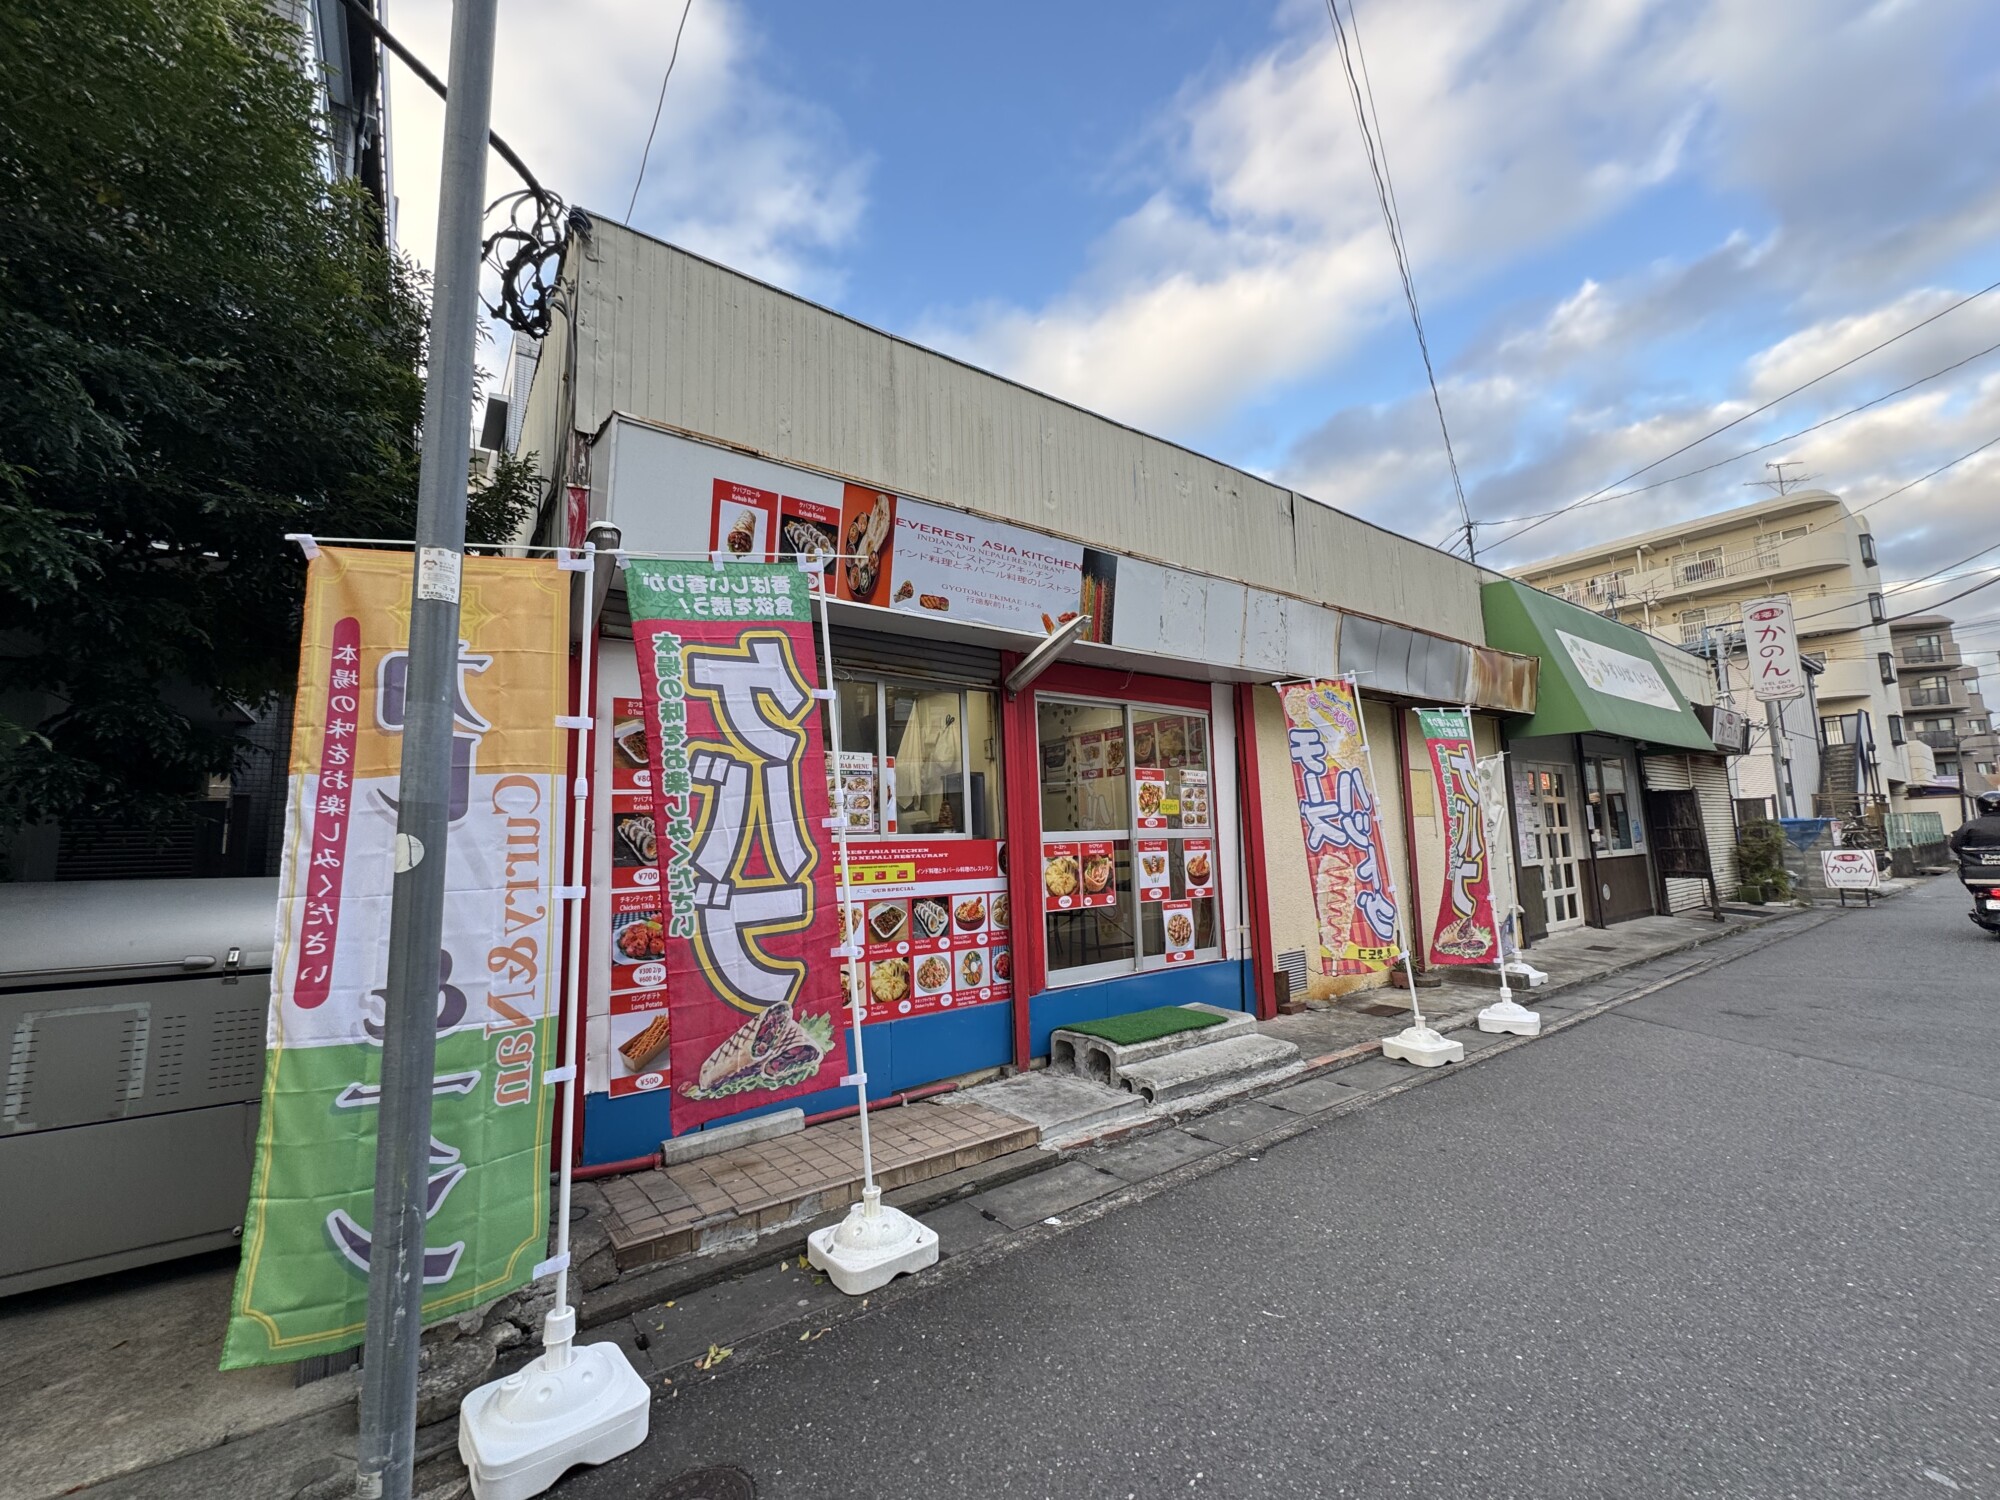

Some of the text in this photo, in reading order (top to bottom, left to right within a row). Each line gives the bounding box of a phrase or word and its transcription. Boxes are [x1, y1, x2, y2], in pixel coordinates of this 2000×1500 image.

[731, 494, 758, 505] Kebab Roll
[798, 509, 813, 518] Kebab
[896, 517, 1084, 572] EVEREST ASIA KITCHEN
[917, 534, 1066, 575] INDIAN AND NEPALI RESTAURANT
[933, 546, 1054, 580] エベレストアジアキッチン
[895, 549, 1080, 595] インド料理とネパール料理のレストラン
[941, 583, 987, 597] GYOTOKU
[989, 593, 1023, 605] EKIMAE
[1755, 624, 1790, 679] かのん
[1161, 803, 1178, 811] open
[893, 852, 949, 860] RESTAURANT
[1828, 863, 1873, 874] かのん
[638, 871, 658, 880] ¥700
[619, 894, 654, 904] チキンティッカ
[619, 904, 641, 912] Chicken
[631, 992, 661, 1002] ロングポテト
[630, 1000, 663, 1011] Long Potato
[639, 1076, 659, 1086] ¥500
